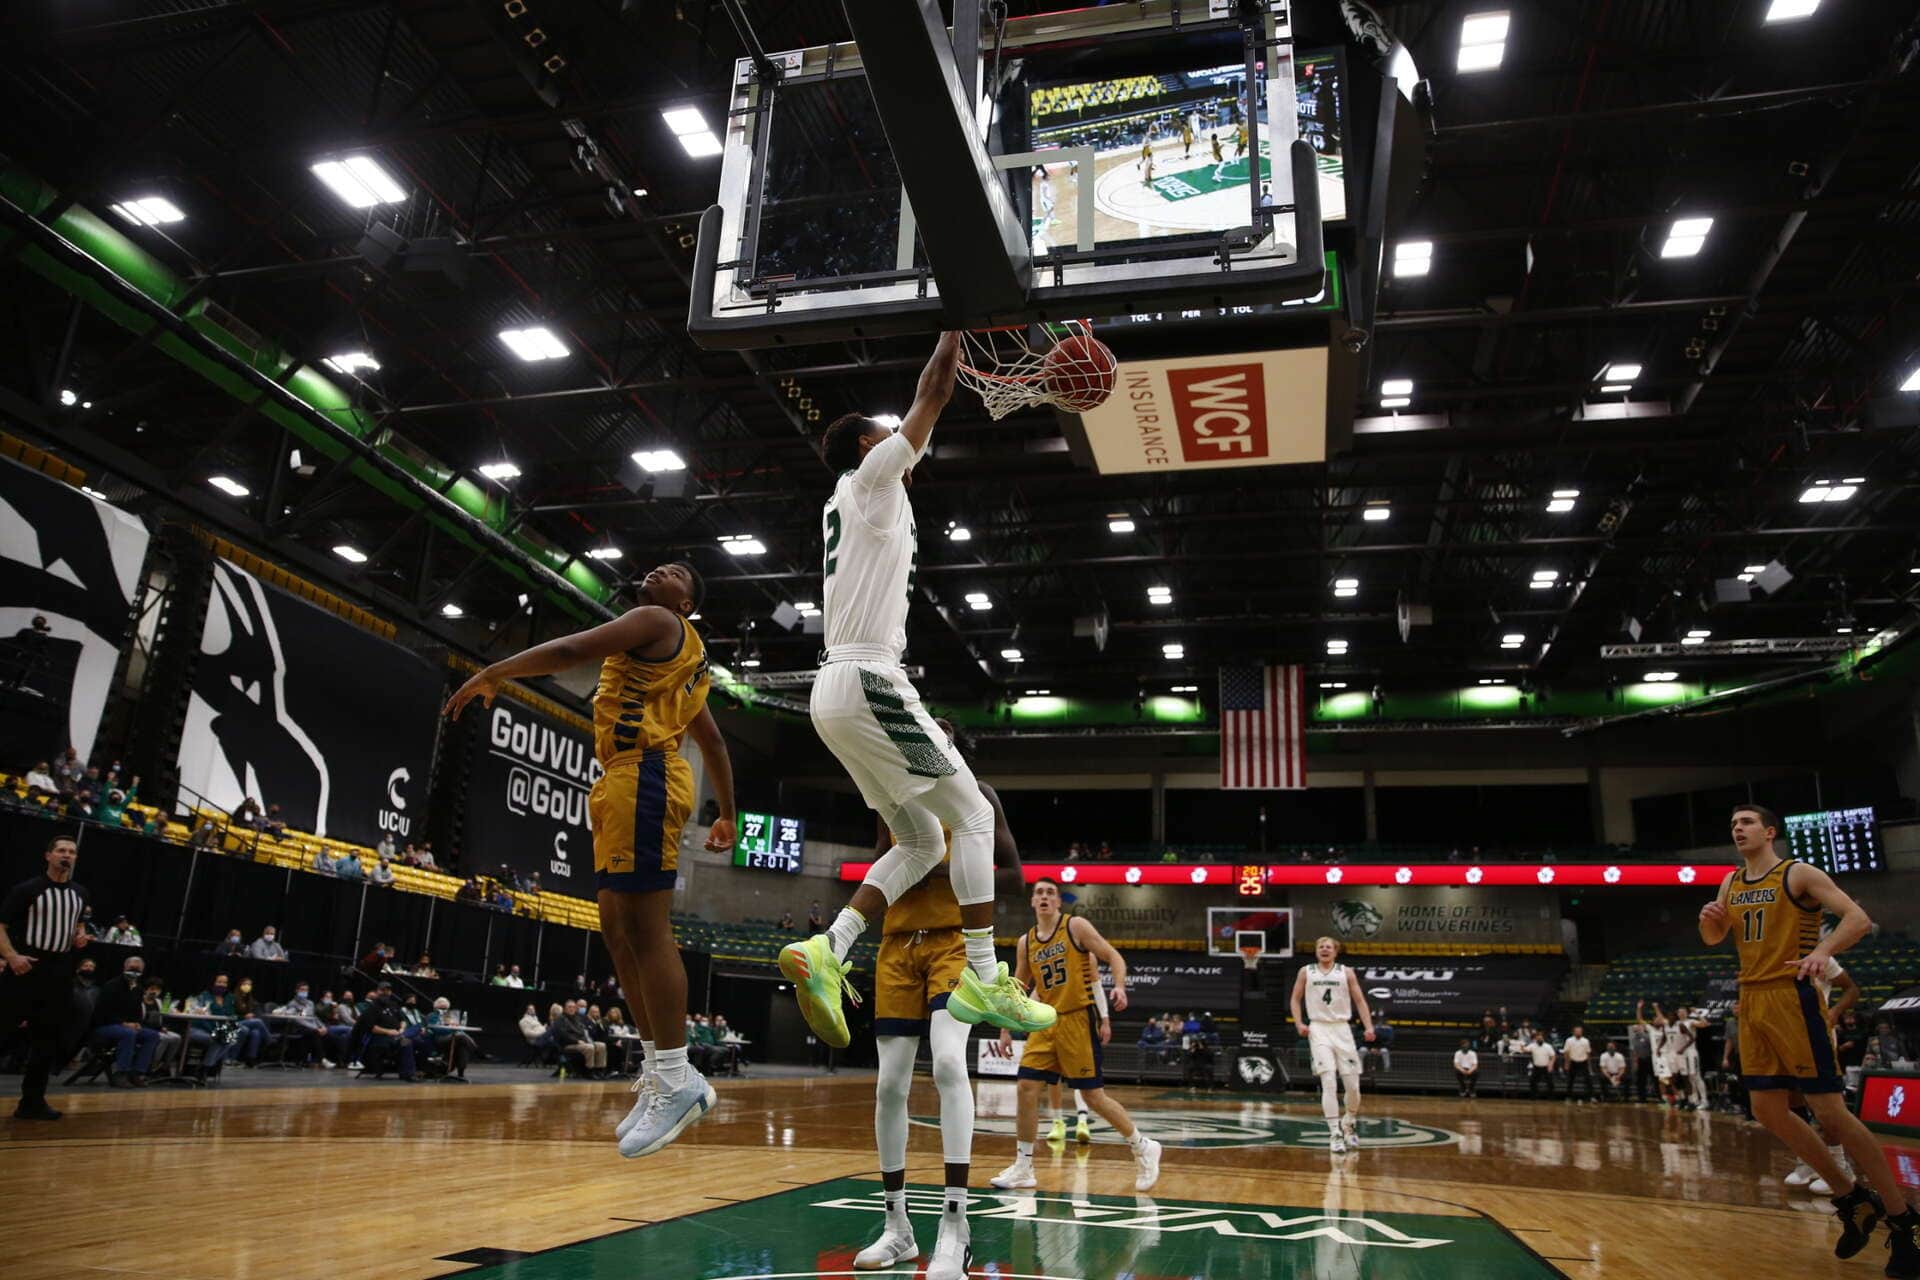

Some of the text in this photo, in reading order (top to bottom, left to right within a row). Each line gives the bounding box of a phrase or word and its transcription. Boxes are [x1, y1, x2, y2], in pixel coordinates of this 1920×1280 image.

[1131, 312, 1163, 322] TOL 4
[1181, 310, 1201, 318] PER
[1218, 306, 1253, 316] 3 TOL
[1124, 369, 1169, 466] INSURANCE
[1187, 372, 1253, 453] WCF
[745, 814, 764, 824] UVU
[780, 819, 798, 828] CBU
[745, 823, 762, 836] 27
[780, 828, 797, 842] 25
[754, 854, 784, 868] 2:01
[1240, 876, 1262, 894] 25
[1730, 888, 1777, 906] LANCERS
[1072, 904, 1178, 926] Community
[1398, 906, 1513, 918] HOME OF THE
[1398, 919, 1514, 933] WOLVERINES
[1744, 908, 1764, 943] 11
[1040, 958, 1067, 990] 25
[1174, 966, 1223, 975] BANK
[1364, 970, 1454, 981] UVU
[1322, 988, 1332, 1006] 4
